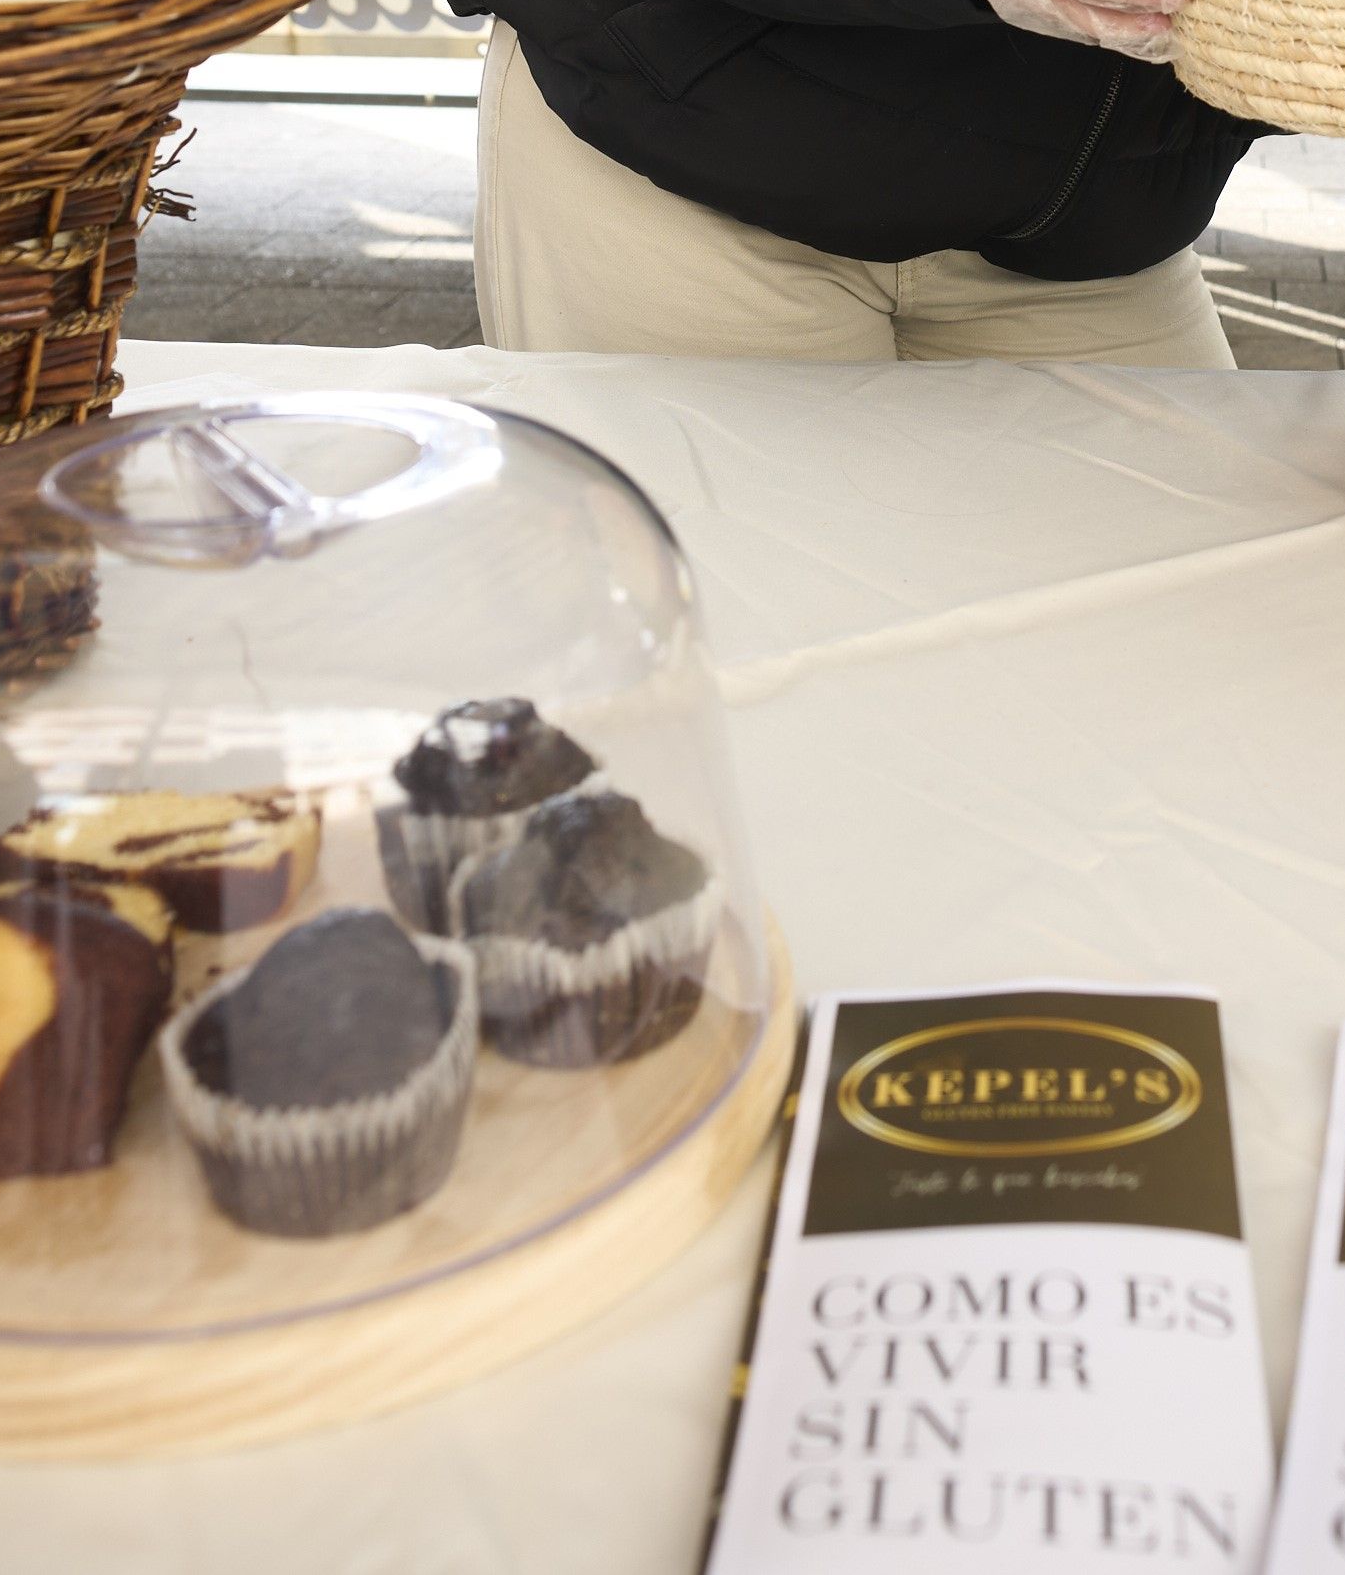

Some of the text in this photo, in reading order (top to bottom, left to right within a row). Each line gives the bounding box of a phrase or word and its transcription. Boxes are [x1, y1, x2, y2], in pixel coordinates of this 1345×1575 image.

[872, 1068, 1171, 1107] KEPEL'S
[811, 1270, 1236, 1339] COMO ES
[809, 1335, 1096, 1393] VIVIR
[788, 1396, 970, 1463] SIN
[776, 1468, 1240, 1561] GLUTEN
